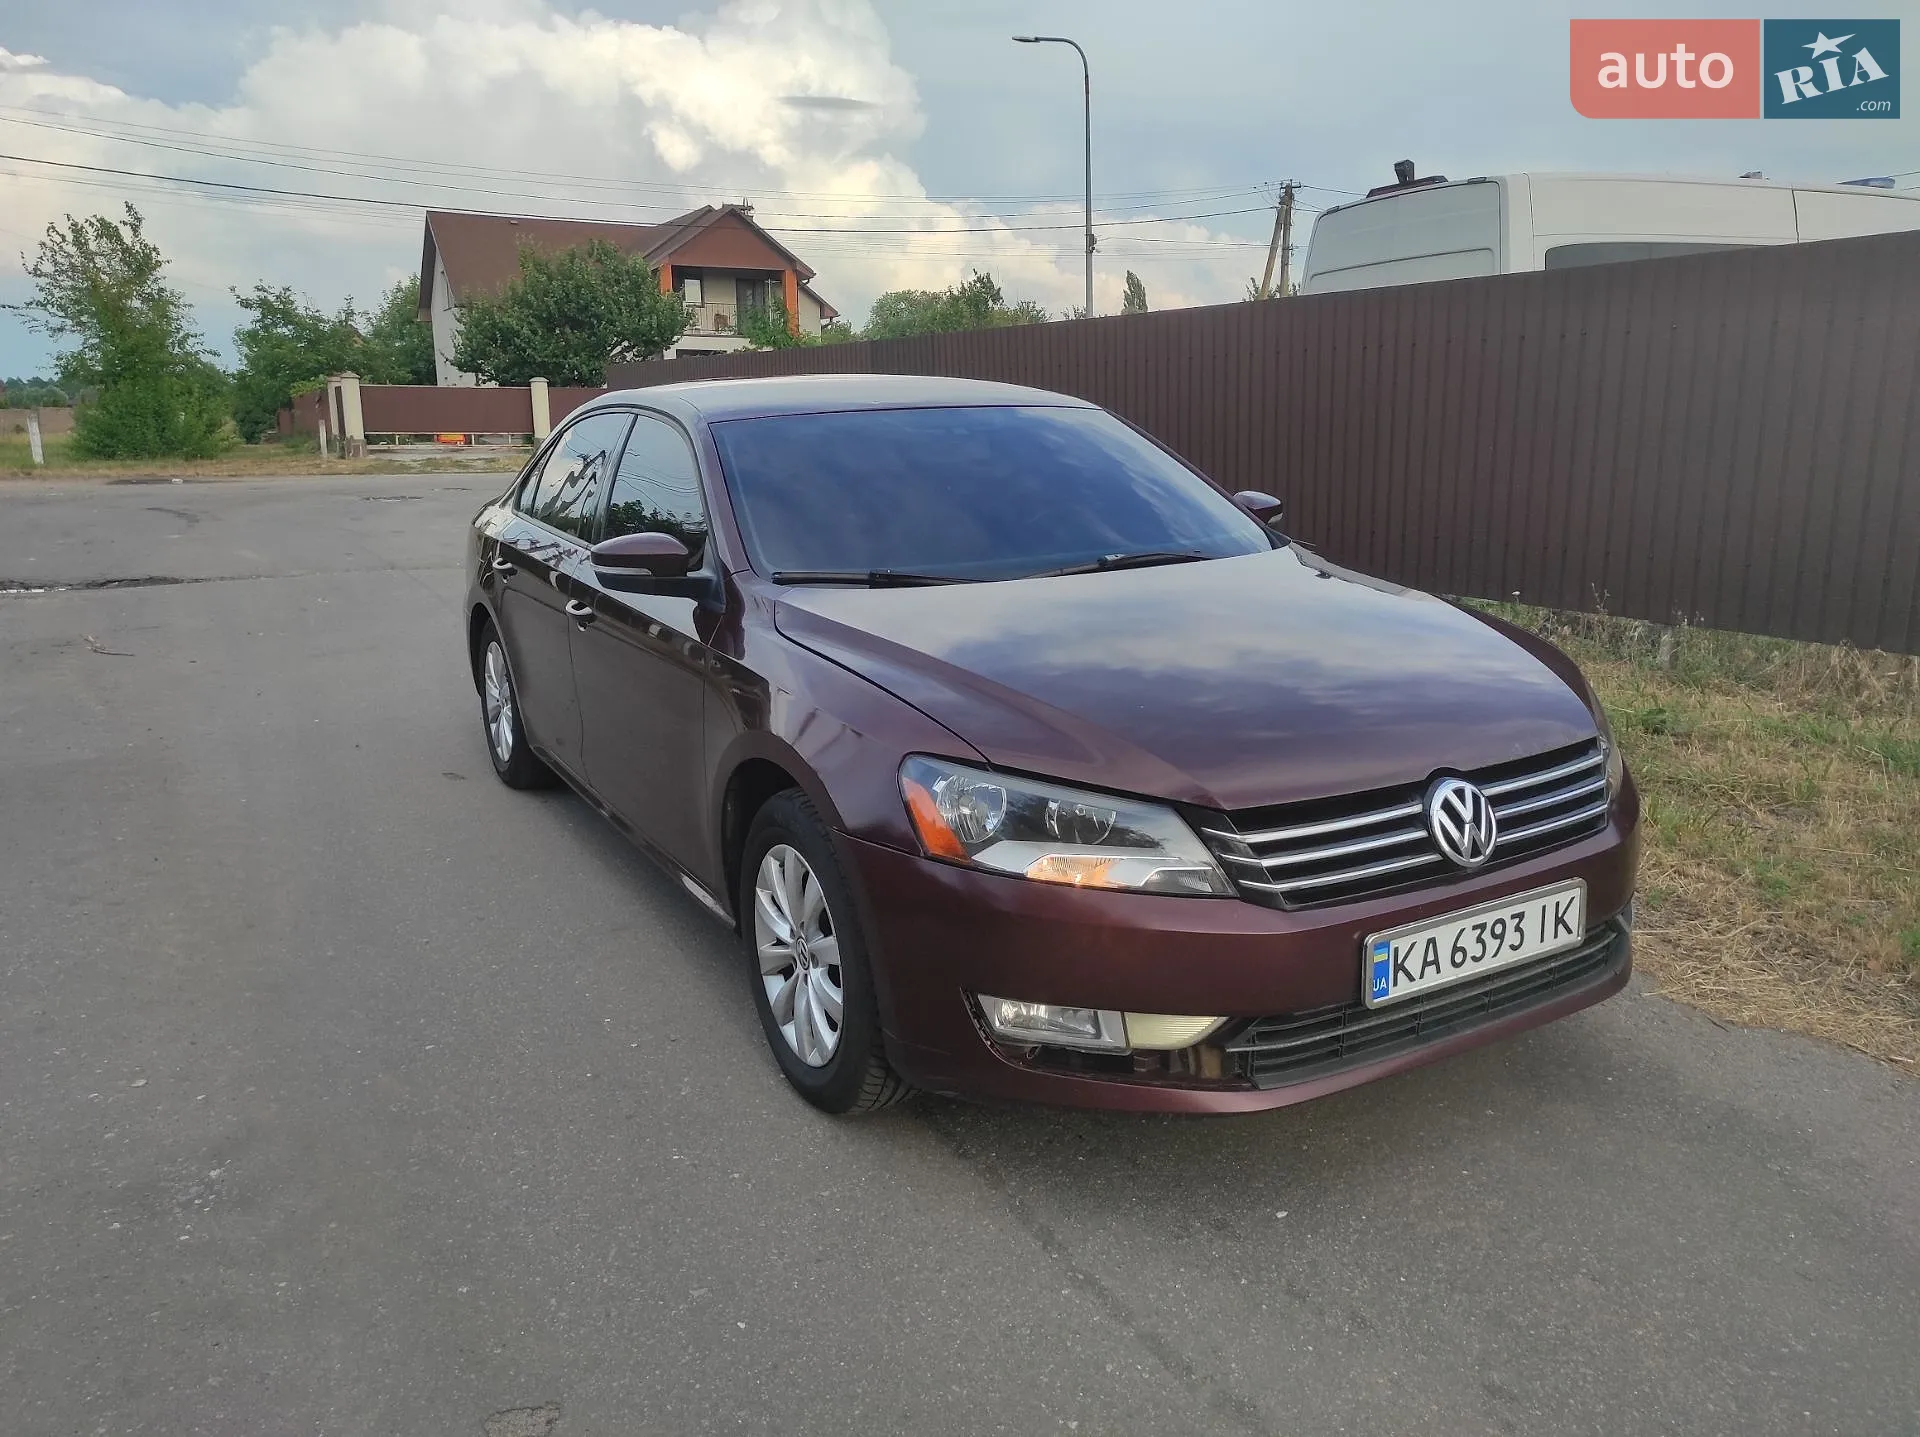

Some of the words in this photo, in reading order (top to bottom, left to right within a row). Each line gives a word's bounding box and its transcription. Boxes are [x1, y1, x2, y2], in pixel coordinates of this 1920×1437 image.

[1392, 936, 1442, 987] KA
[1450, 911, 1526, 969] 6393
[1539, 895, 1576, 944] IK
[1373, 977, 1388, 992] UA
